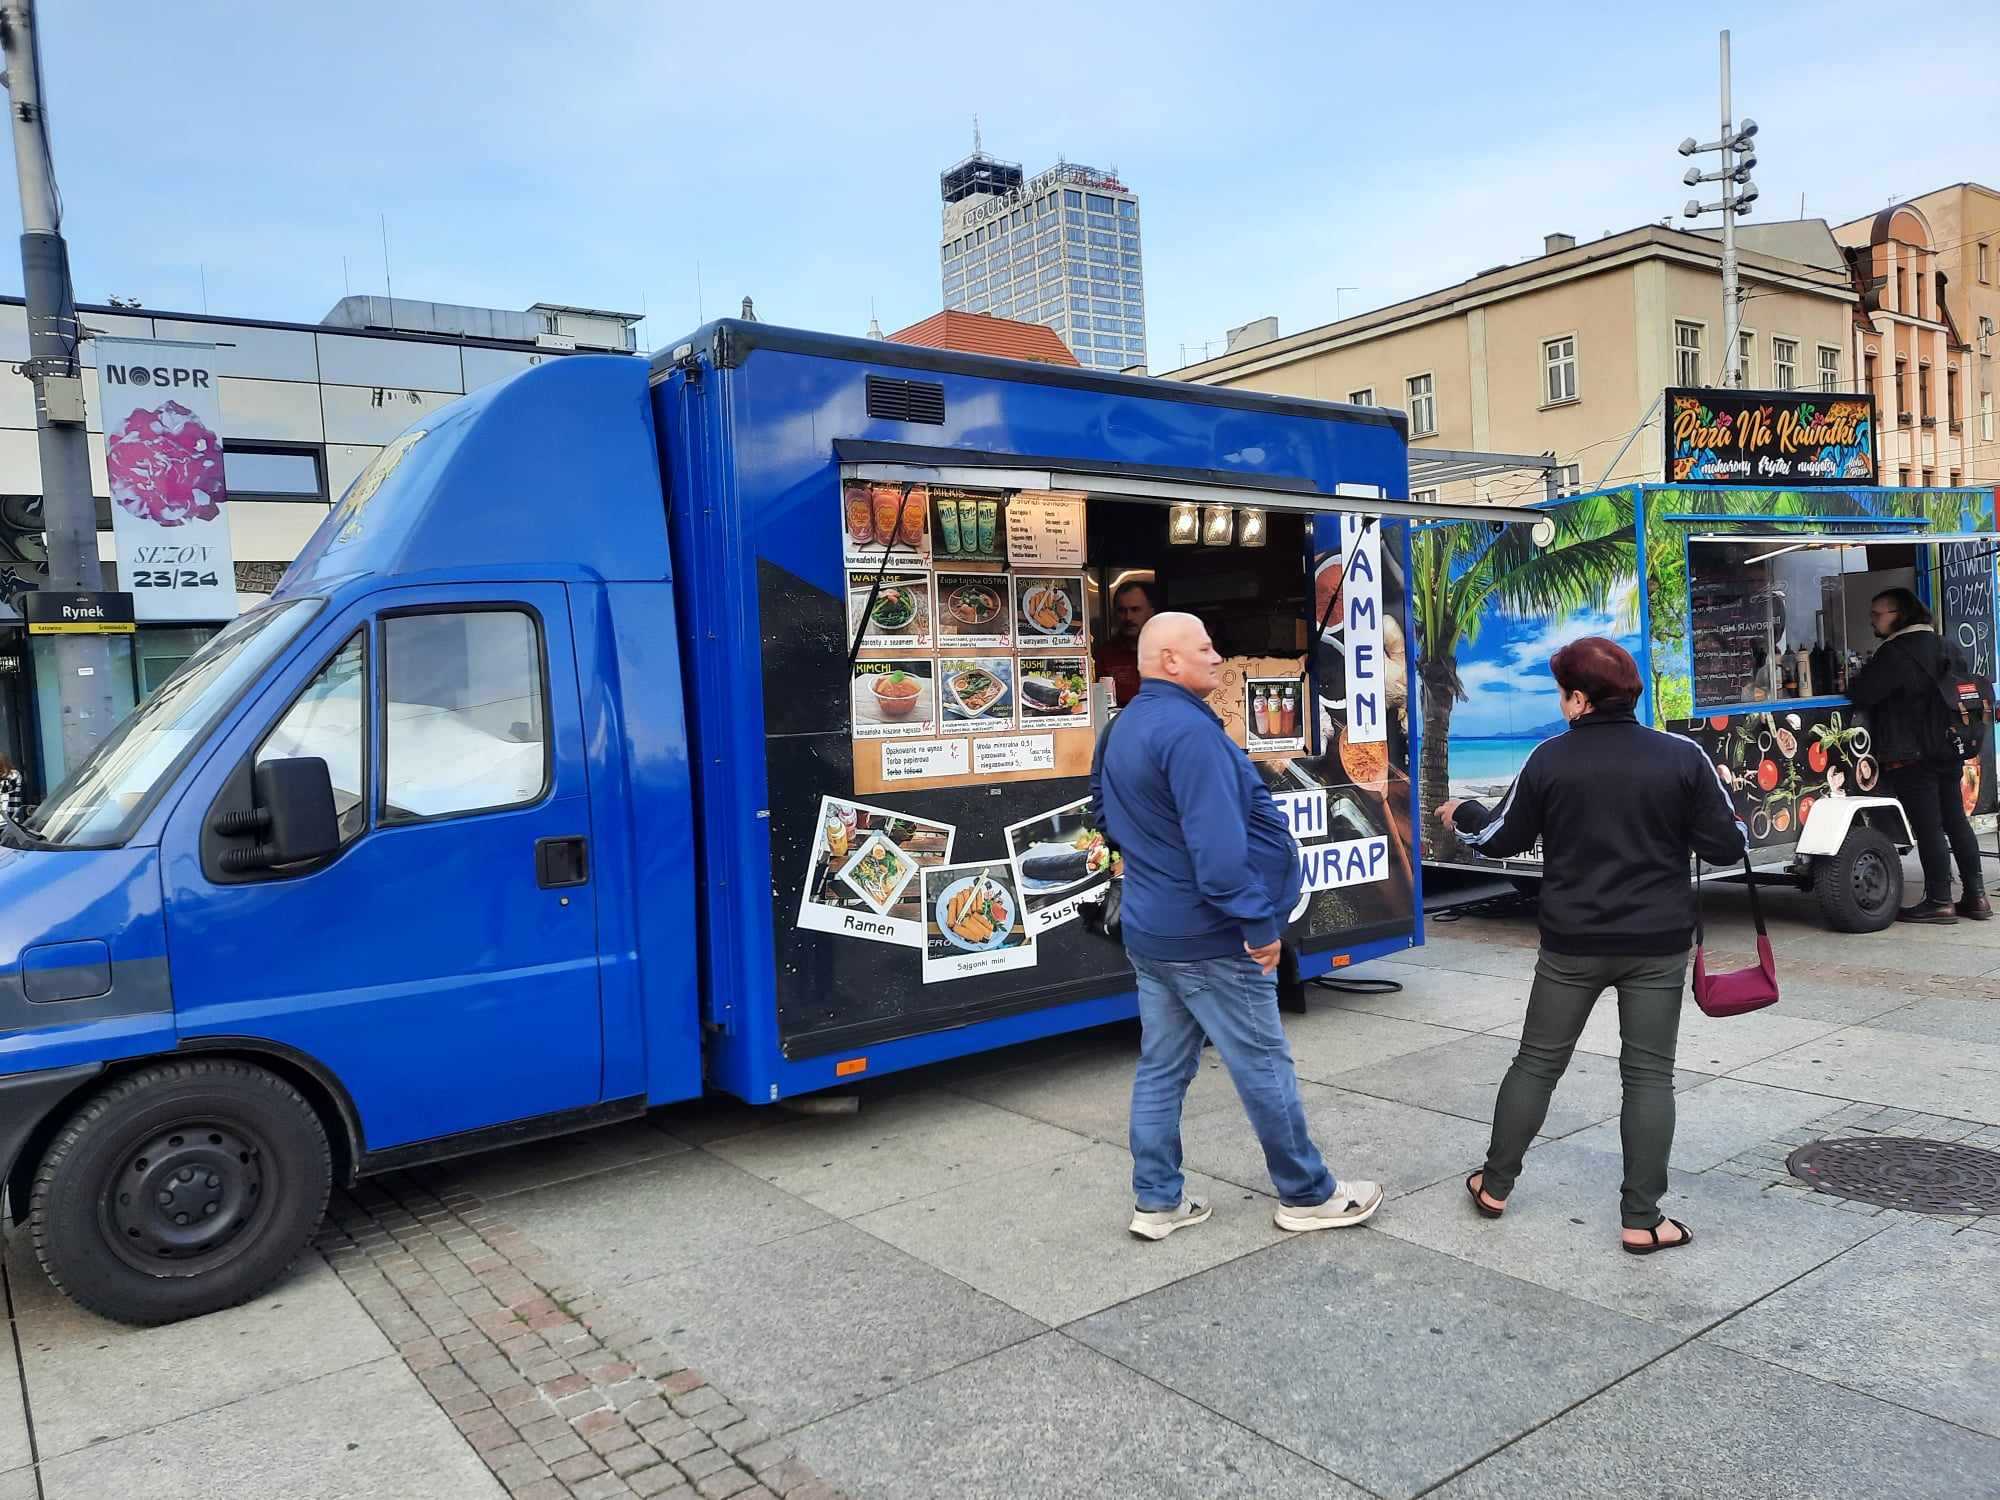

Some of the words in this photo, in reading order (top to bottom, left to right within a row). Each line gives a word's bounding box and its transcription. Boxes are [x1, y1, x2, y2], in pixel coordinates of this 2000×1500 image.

[966, 169, 1057, 226] COURTYARD
[106, 364, 210, 388] NOSPR
[1674, 409, 1732, 450] Pizza
[1736, 409, 1773, 452] Na
[1701, 459, 1751, 475] makarony
[1758, 455, 1790, 477] frytki
[1798, 458, 1837, 475] nuggetsy
[133, 546, 216, 564] SEZON
[133, 569, 218, 588] 23/24
[1947, 578, 1993, 617] PIZZY
[62, 605, 104, 620] Rynek
[856, 663, 891, 673] KIMCHI
[1020, 661, 1044, 669] SUSHI
[993, 740, 1018, 748] mineralna
[887, 757, 901, 765] Torba
[904, 756, 929, 766] papierowa
[844, 915, 895, 936] Ramen
[957, 960, 988, 971] Sajgonki
[991, 957, 1006, 965] mini
